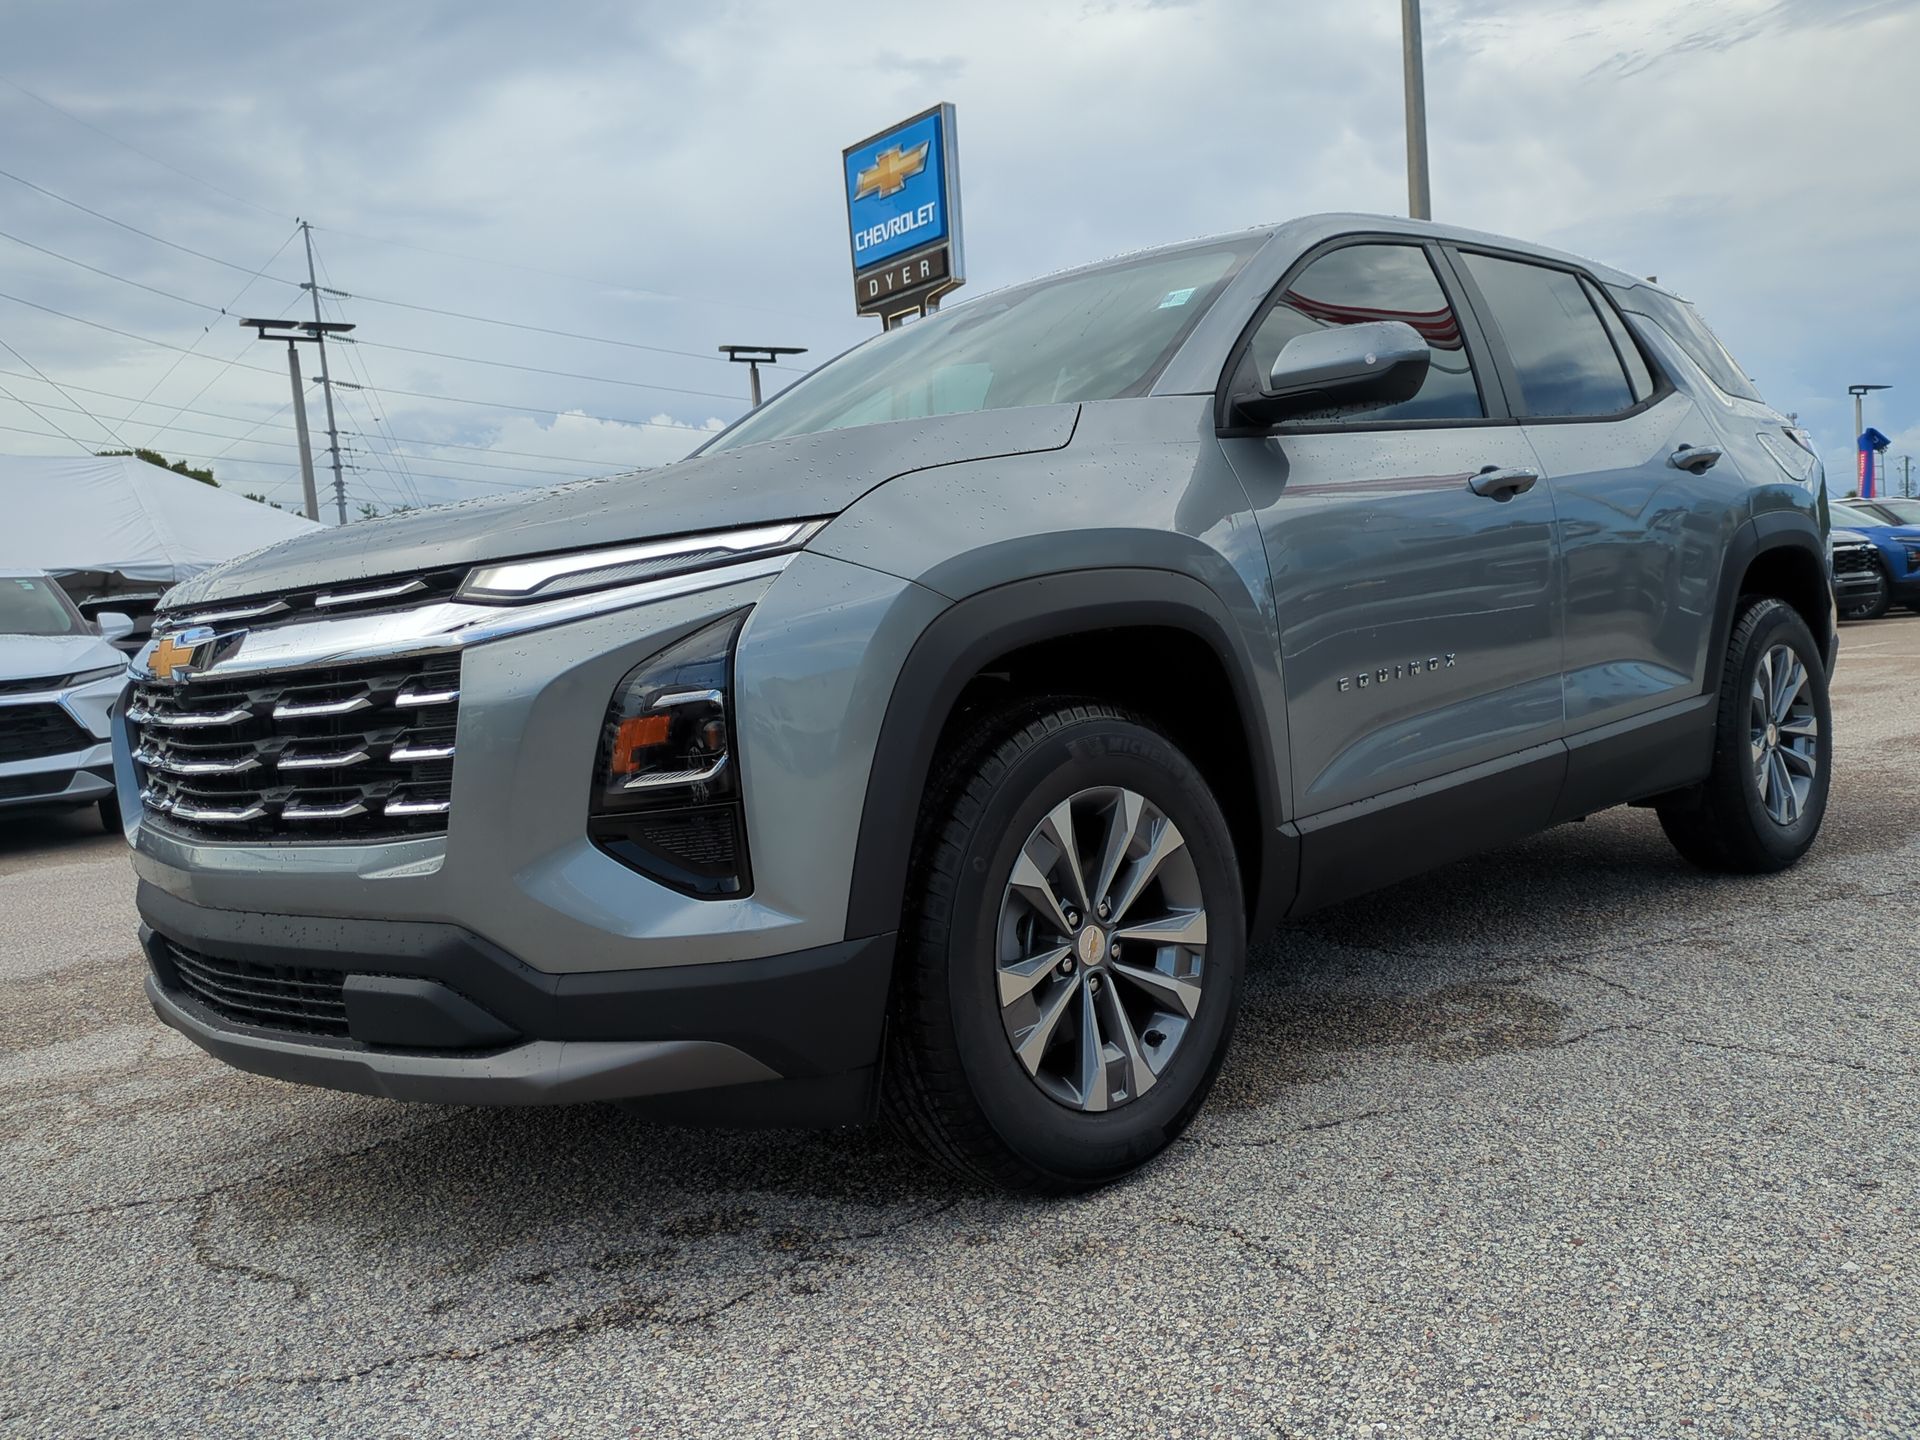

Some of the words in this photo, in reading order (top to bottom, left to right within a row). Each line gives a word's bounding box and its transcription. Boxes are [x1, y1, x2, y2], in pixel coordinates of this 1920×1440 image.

[855, 201, 936, 252] CHEVROLET
[869, 259, 930, 297] DYER
[1338, 653, 1456, 692] EQUINOX
